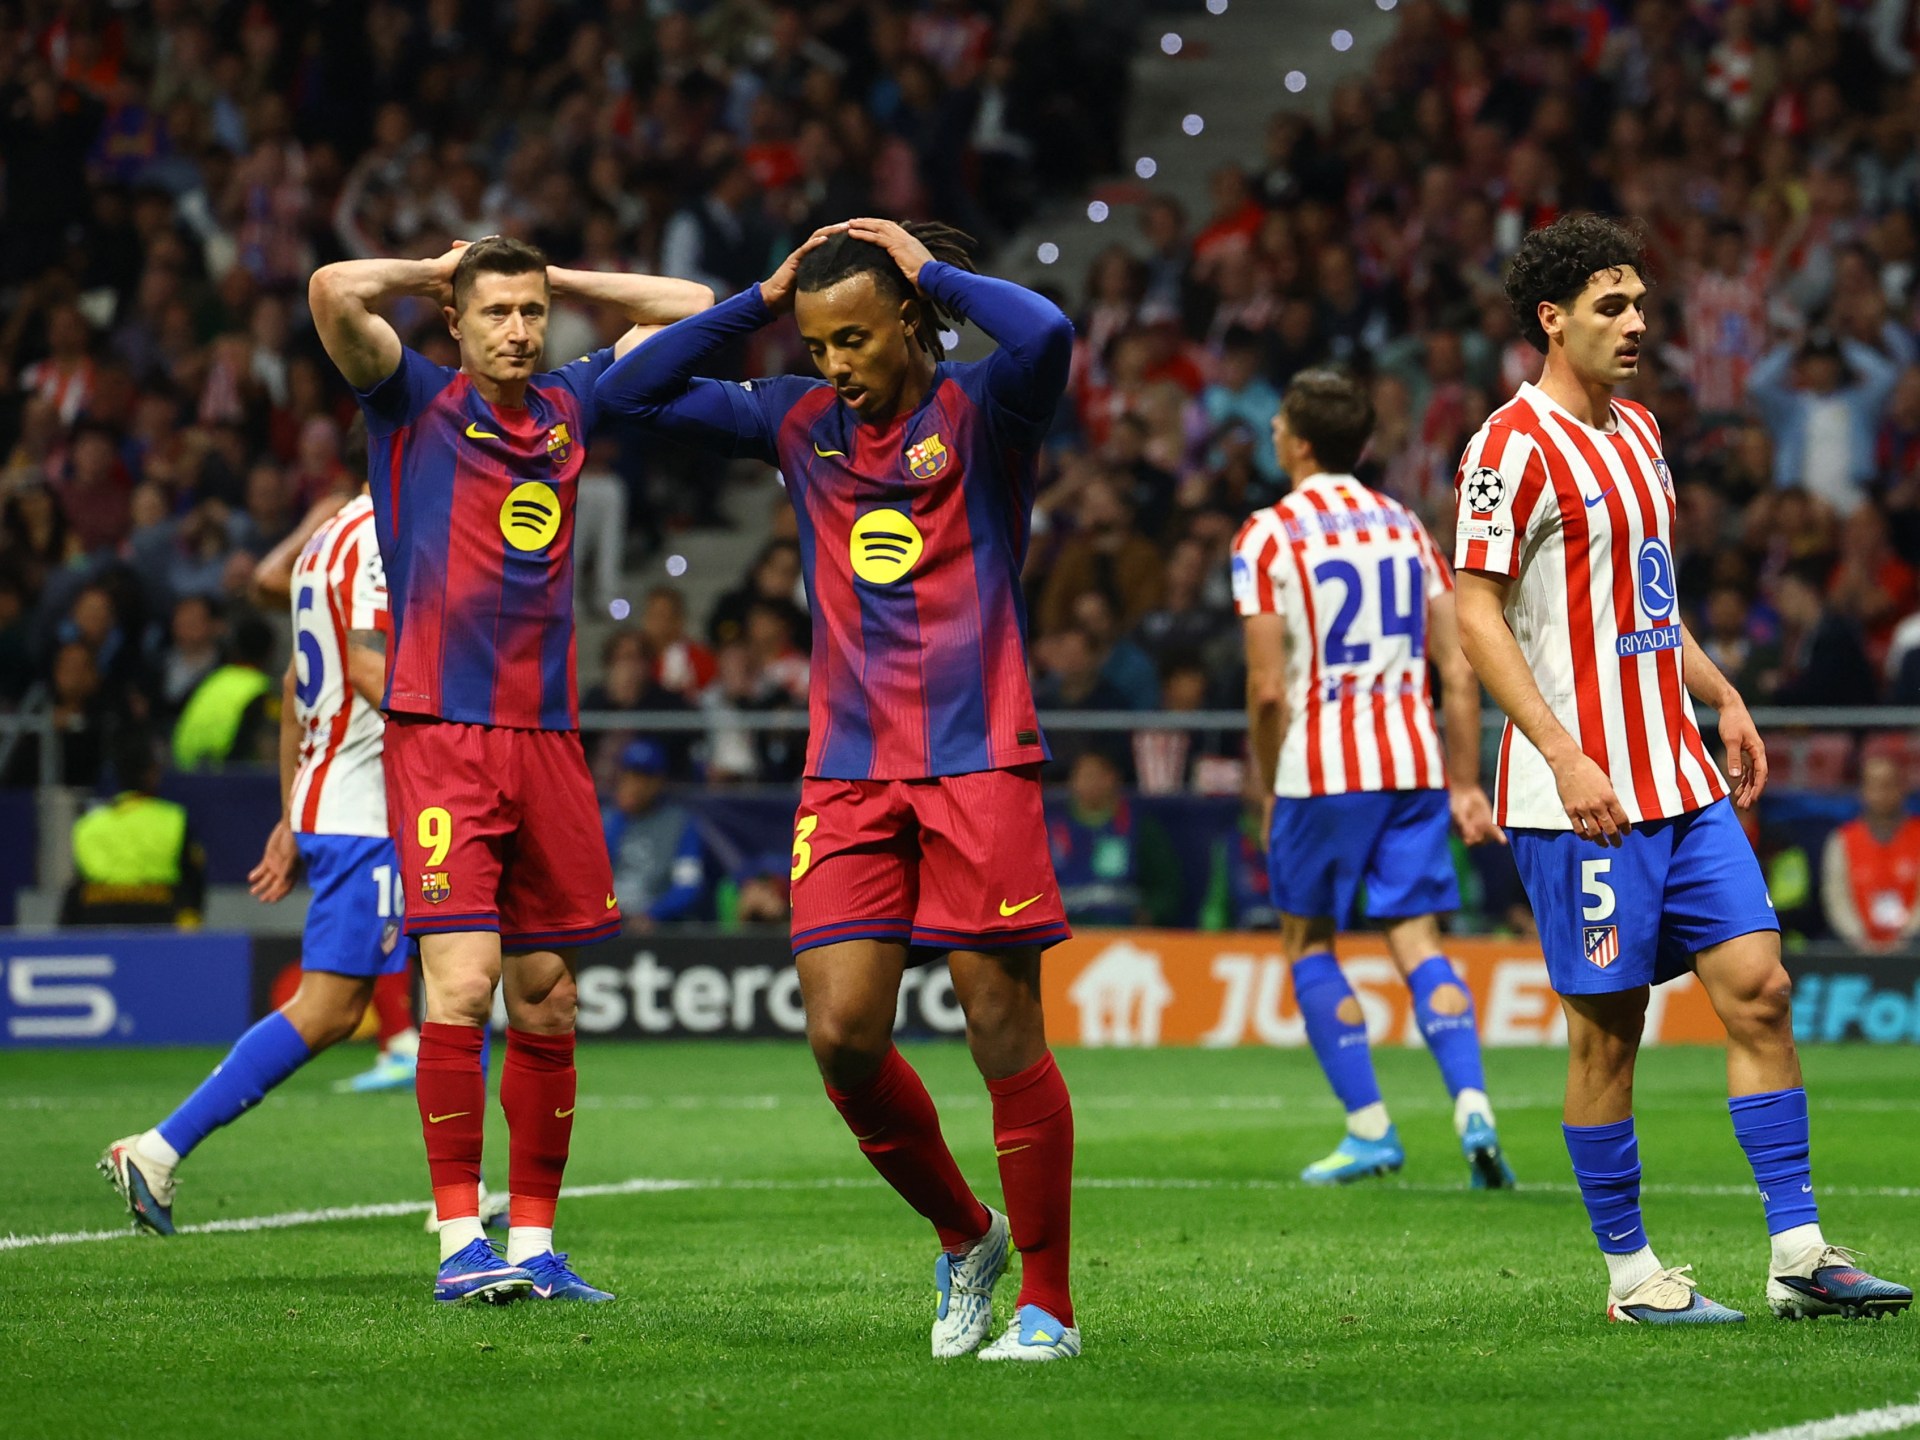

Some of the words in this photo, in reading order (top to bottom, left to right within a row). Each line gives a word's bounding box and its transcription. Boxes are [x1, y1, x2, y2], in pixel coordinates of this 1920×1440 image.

[1314, 555, 1423, 665] 24
[1620, 627, 1677, 654] RIYADH
[418, 807, 451, 867] 9
[1581, 858, 1616, 921] 5
